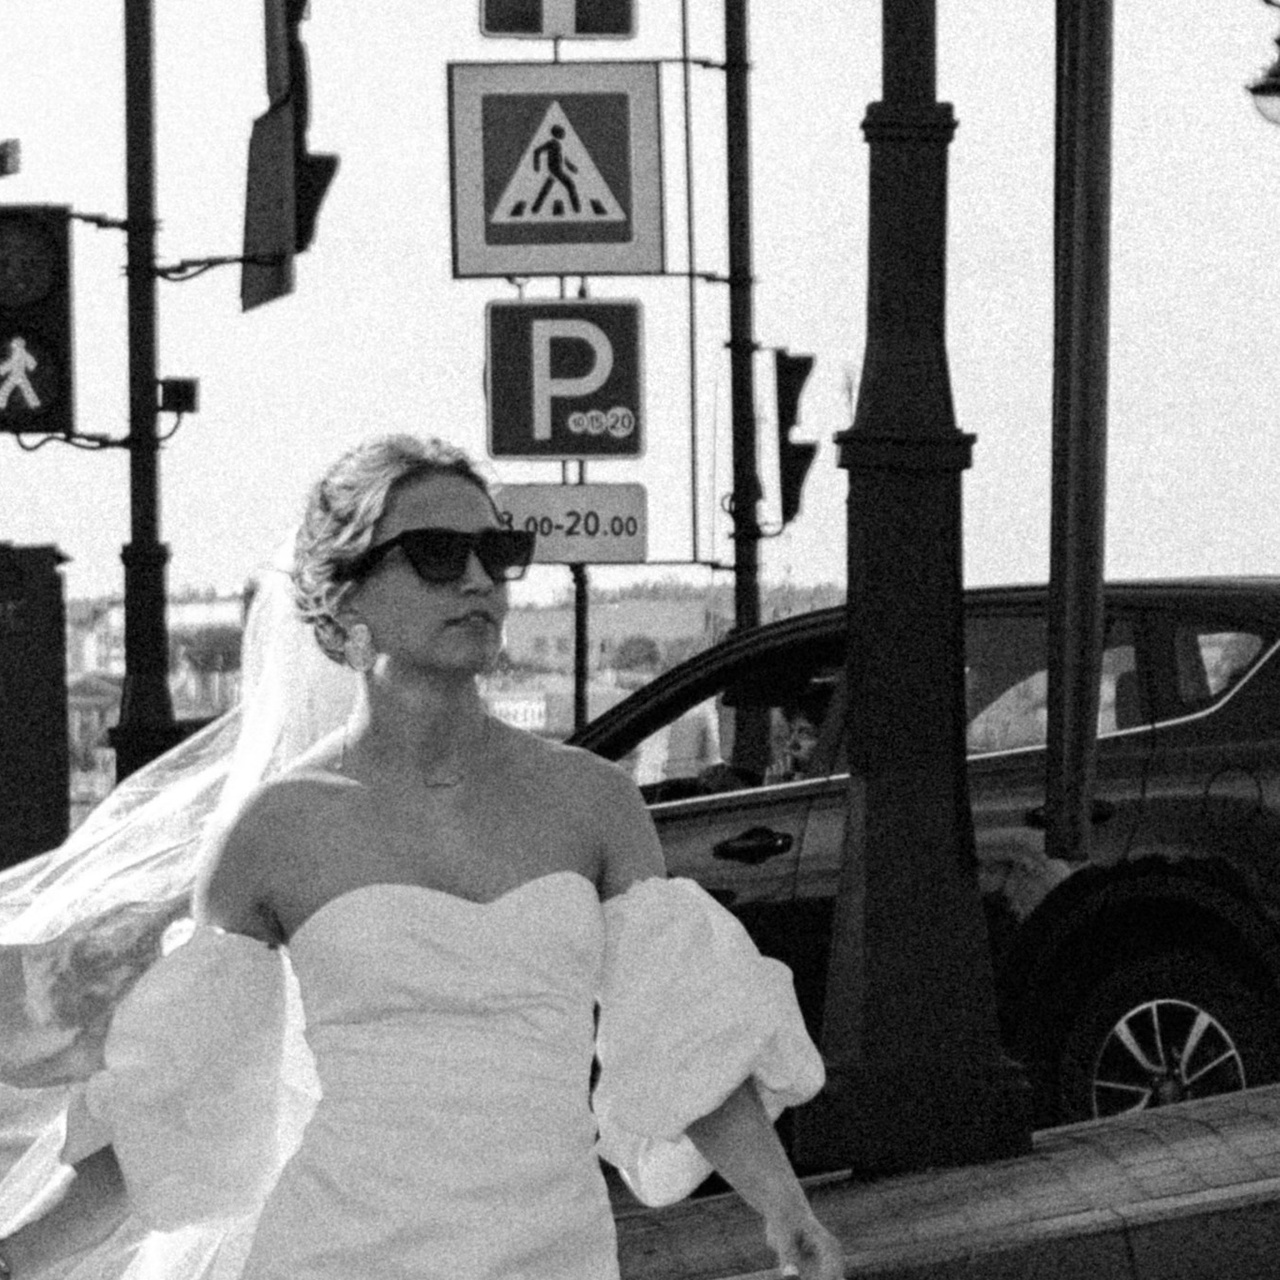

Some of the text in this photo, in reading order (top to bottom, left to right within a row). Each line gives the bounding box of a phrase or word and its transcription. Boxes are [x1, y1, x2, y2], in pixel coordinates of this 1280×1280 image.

[532, 319, 614, 440] P
[609, 412, 633, 431] 20
[500, 510, 638, 536] 800-20.00
